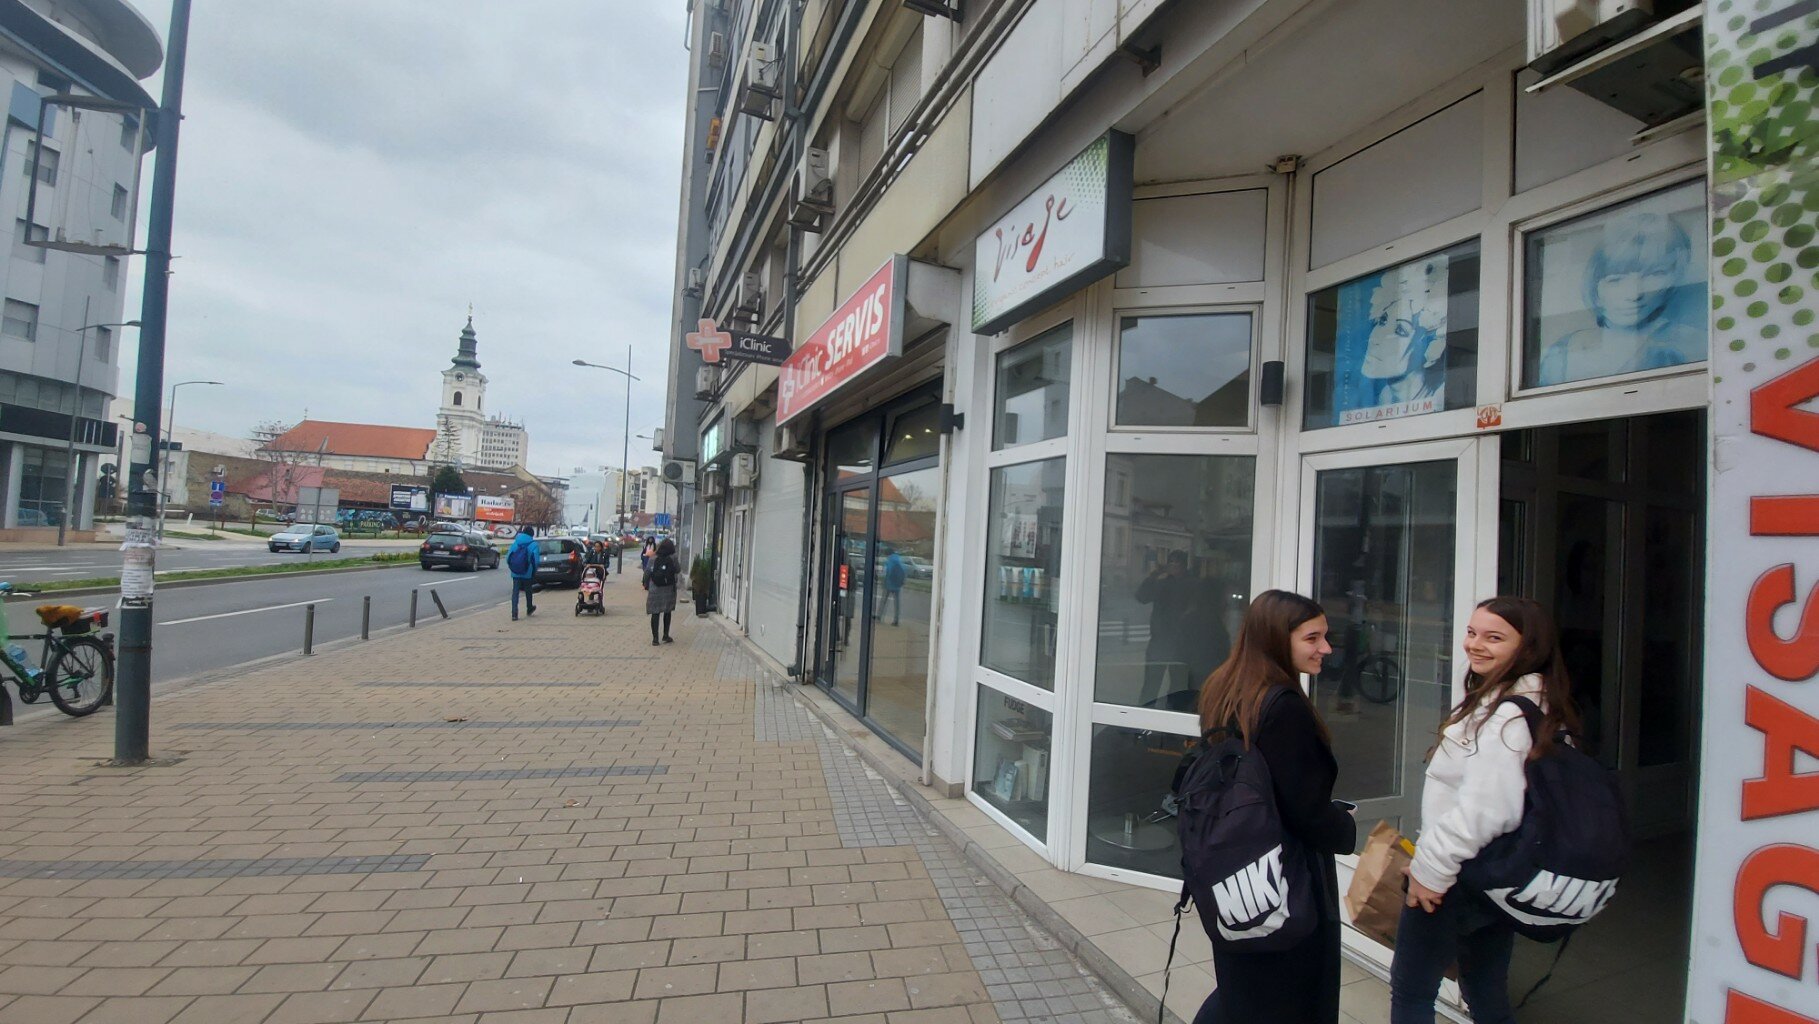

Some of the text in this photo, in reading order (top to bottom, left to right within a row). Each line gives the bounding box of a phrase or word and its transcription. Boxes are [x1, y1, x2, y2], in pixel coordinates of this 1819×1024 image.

[825, 283, 885, 371] SERVIS
[740, 337, 772, 353] iClinic
[1345, 400, 1433, 422] SOLARIJUM
[1004, 696, 1025, 715] FUDGE
